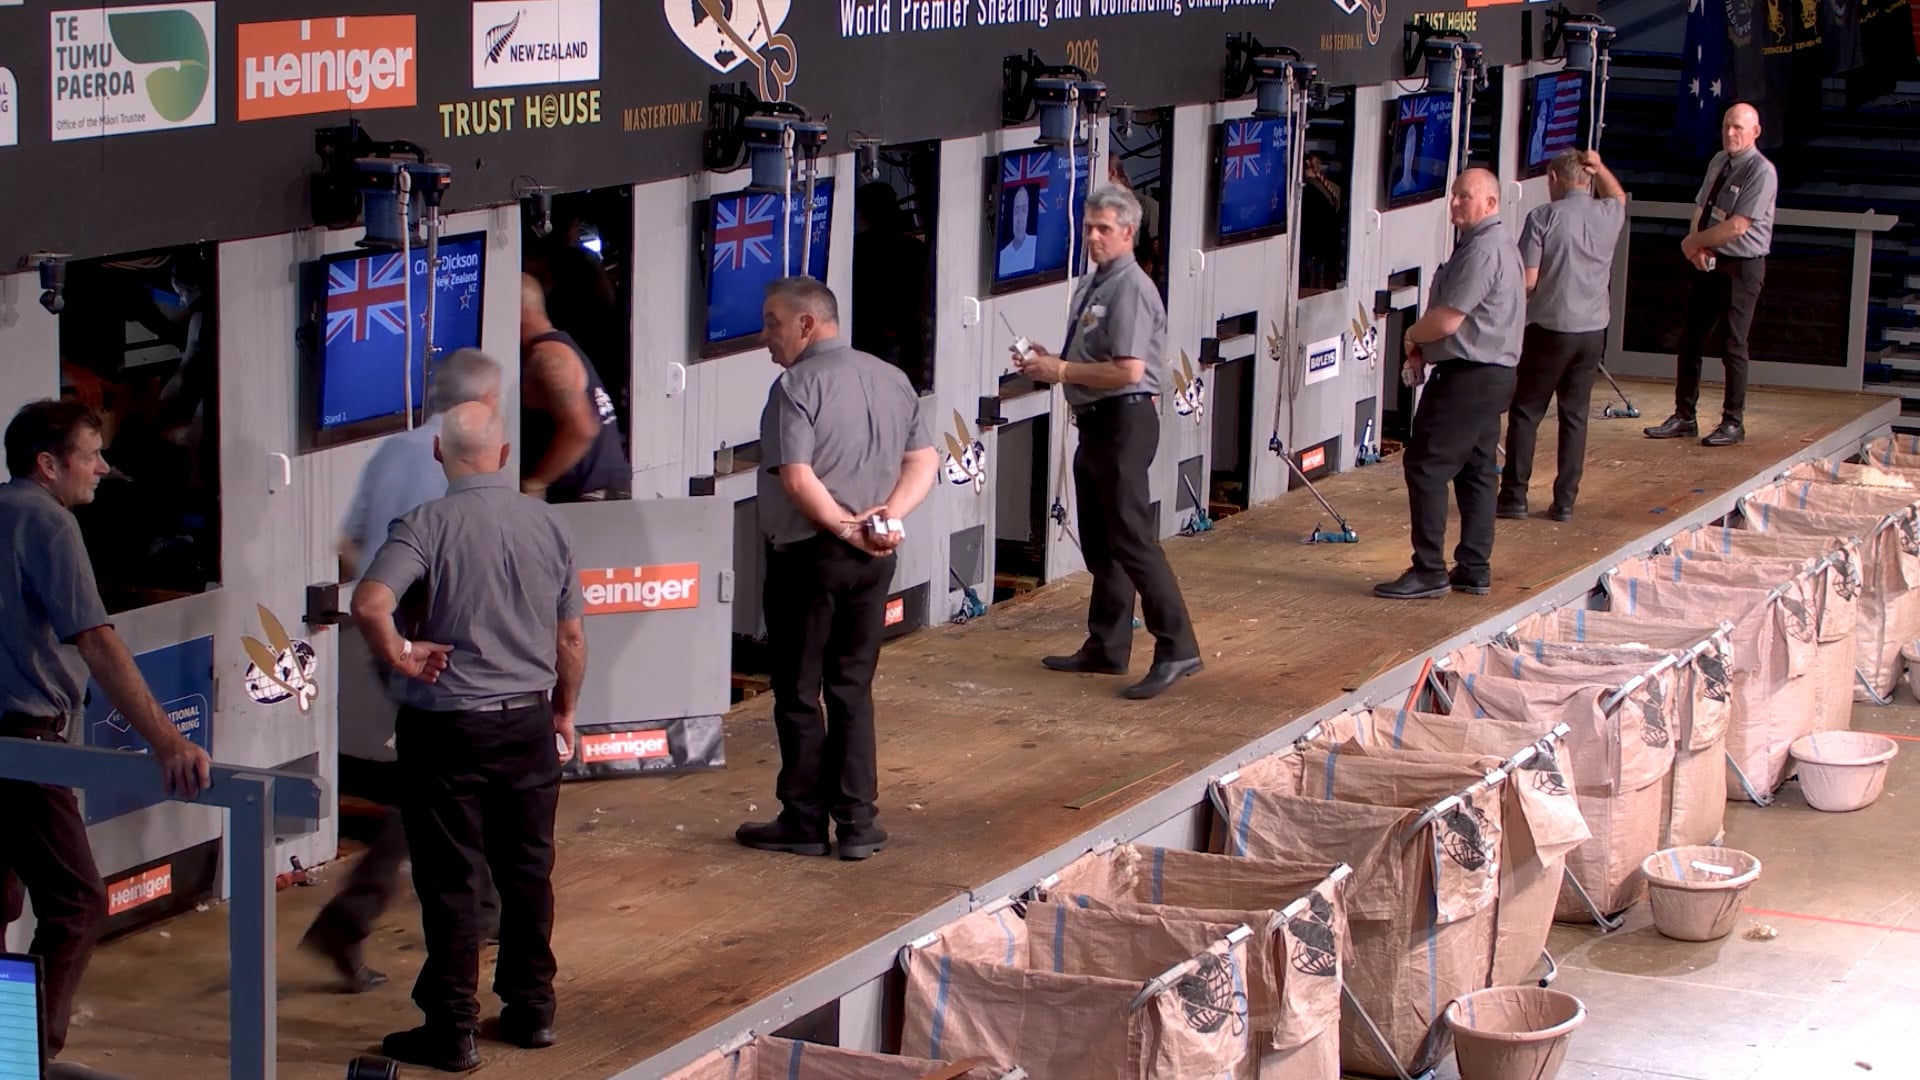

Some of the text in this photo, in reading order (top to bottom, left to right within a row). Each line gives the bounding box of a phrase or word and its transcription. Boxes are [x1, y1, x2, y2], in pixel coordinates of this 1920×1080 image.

[56, 16, 78, 42] TE
[840, 0, 890, 37] World
[900, 0, 969, 32] Premier
[977, 0, 1048, 27] Shearing
[1056, 0, 1081, 19] and
[1414, 11, 1477, 31] TUST HOUSE
[56, 43, 112, 71] TUMU
[246, 17, 412, 104] Heiniger
[510, 41, 588, 62] NEW ZEALAND
[1066, 39, 1098, 74] 2026
[57, 70, 135, 101] PAEROA
[57, 119, 76, 131] Office
[78, 117, 85, 128] of
[87, 117, 98, 127] the
[120, 113, 146, 124] Trustee
[439, 90, 600, 138] TRUST HOUSE
[624, 101, 703, 131] MASTERTON.NZ
[442, 253, 478, 271] Dickson
[583, 567, 697, 607] einiger
[168, 705, 200, 722] TIONAL
[585, 732, 666, 756] Heiniger
[111, 872, 170, 908] Heiniger
